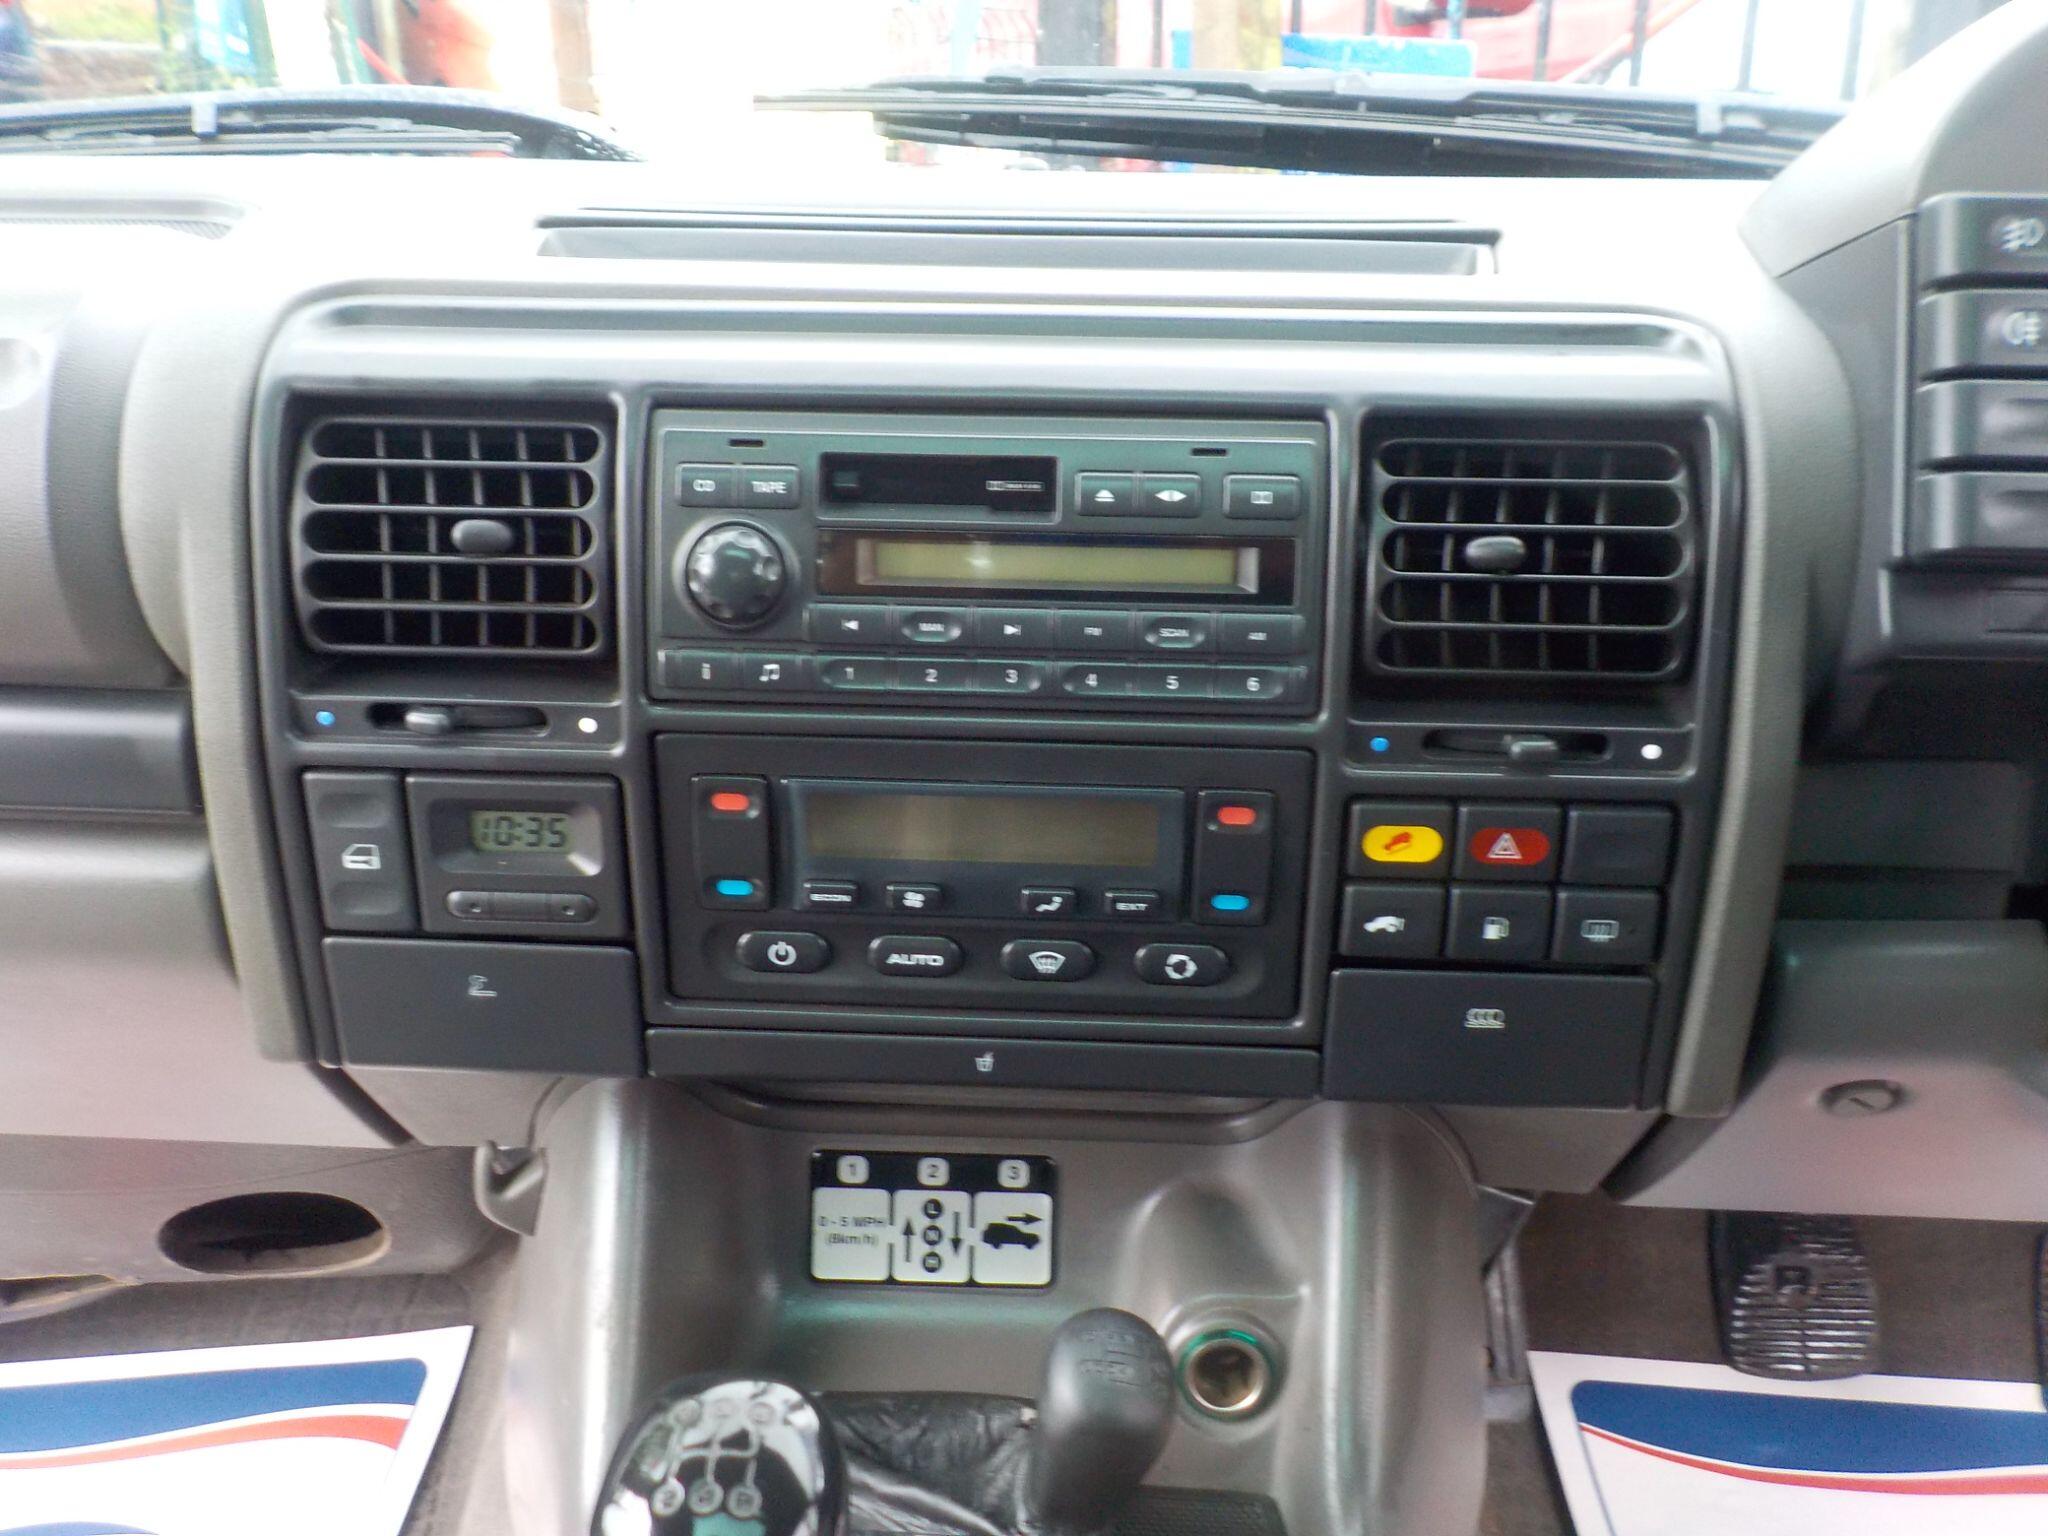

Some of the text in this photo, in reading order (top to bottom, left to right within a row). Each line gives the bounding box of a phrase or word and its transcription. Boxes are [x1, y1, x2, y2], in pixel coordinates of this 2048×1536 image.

[752, 480, 788, 494] TAPE
[845, 667, 855, 680] 1
[924, 668, 938, 682] 2
[1004, 669, 1018, 684] 3
[1084, 673, 1098, 688] 4
[1165, 675, 1179, 690] 5
[1245, 677, 1260, 692] 6
[482, 816, 566, 849] 10:35
[885, 952, 945, 967] AUTO
[926, 1163, 938, 1178] 2
[1007, 1165, 1020, 1180] 3
